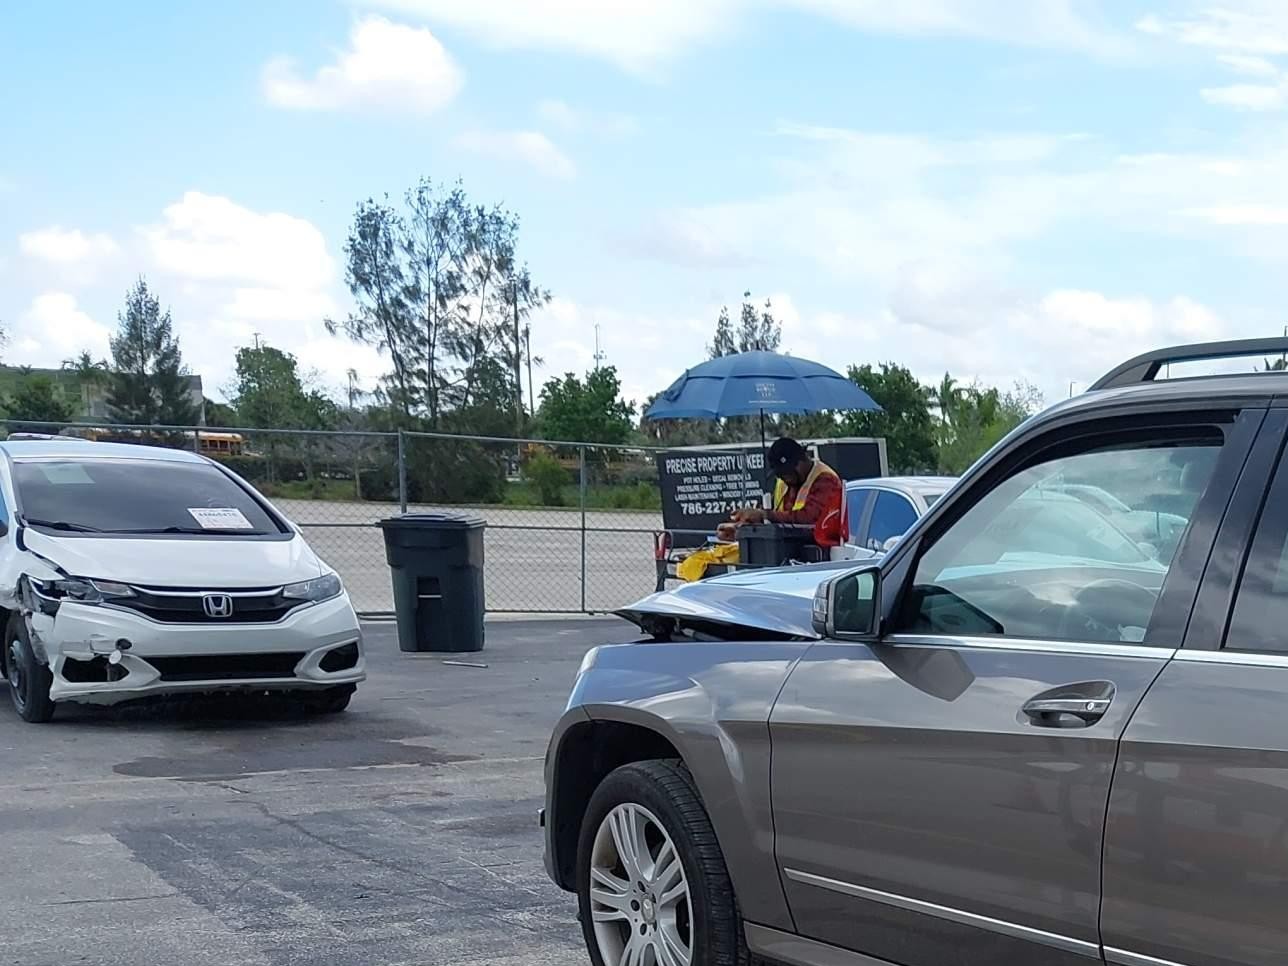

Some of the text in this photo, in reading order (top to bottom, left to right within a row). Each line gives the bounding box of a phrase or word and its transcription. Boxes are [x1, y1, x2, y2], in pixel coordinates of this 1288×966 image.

[665, 454, 765, 474] PRECISE PROPERTY UKEE
